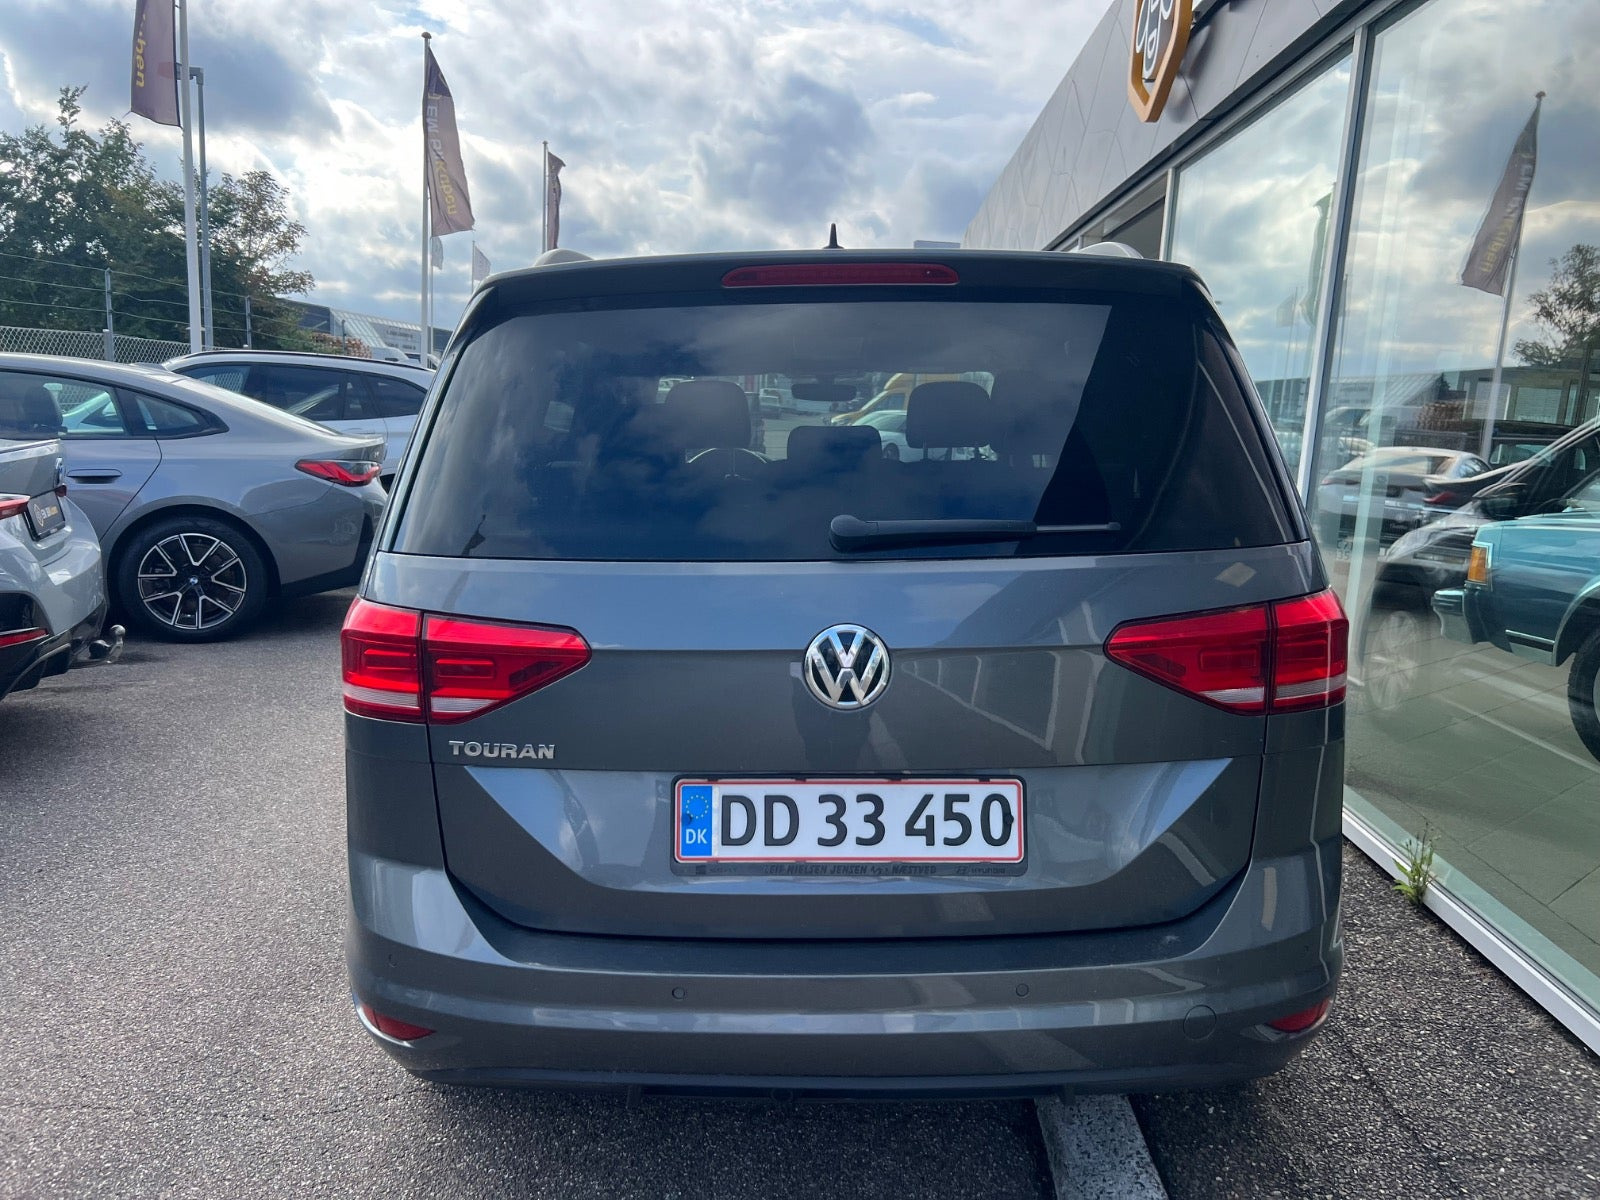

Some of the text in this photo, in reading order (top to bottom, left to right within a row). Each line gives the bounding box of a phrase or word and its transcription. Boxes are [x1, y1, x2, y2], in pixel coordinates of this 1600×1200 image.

[449, 740, 555, 759] TOURAN
[721, 793, 1013, 847] DD 33 450
[685, 828, 707, 844] DK
[787, 864, 828, 875] NIELSEN
[829, 865, 868, 874] JENSEN
